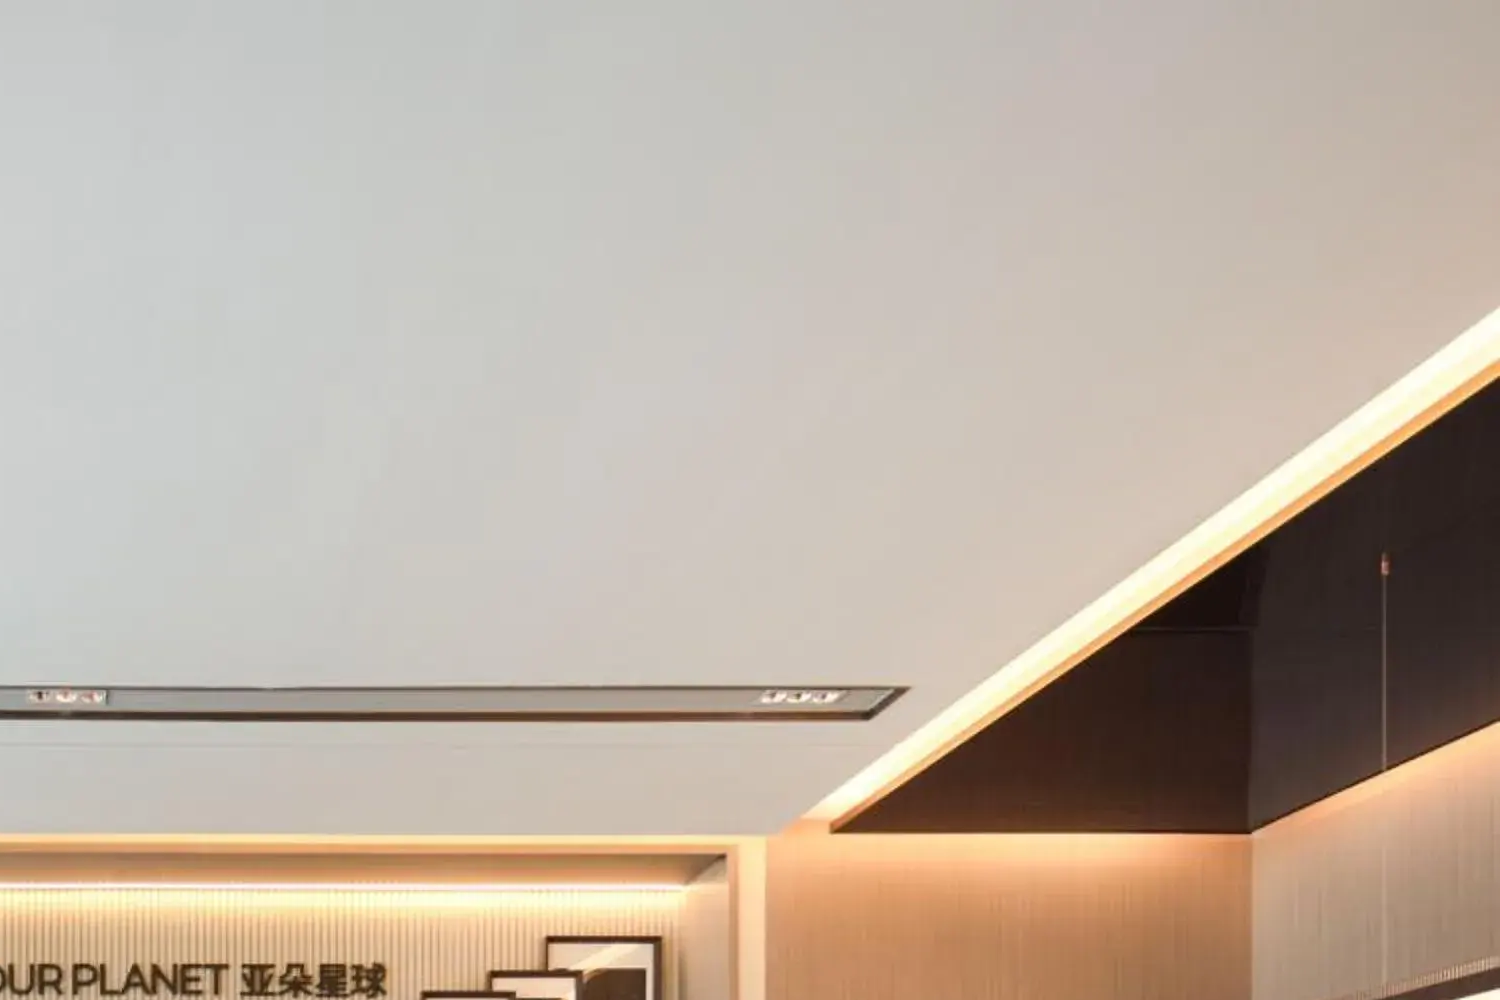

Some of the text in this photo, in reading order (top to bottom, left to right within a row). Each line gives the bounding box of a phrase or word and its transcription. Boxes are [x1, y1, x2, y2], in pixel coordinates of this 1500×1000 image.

[71, 962, 229, 996] PLANET
[240, 962, 387, 998] 亚朵星球
